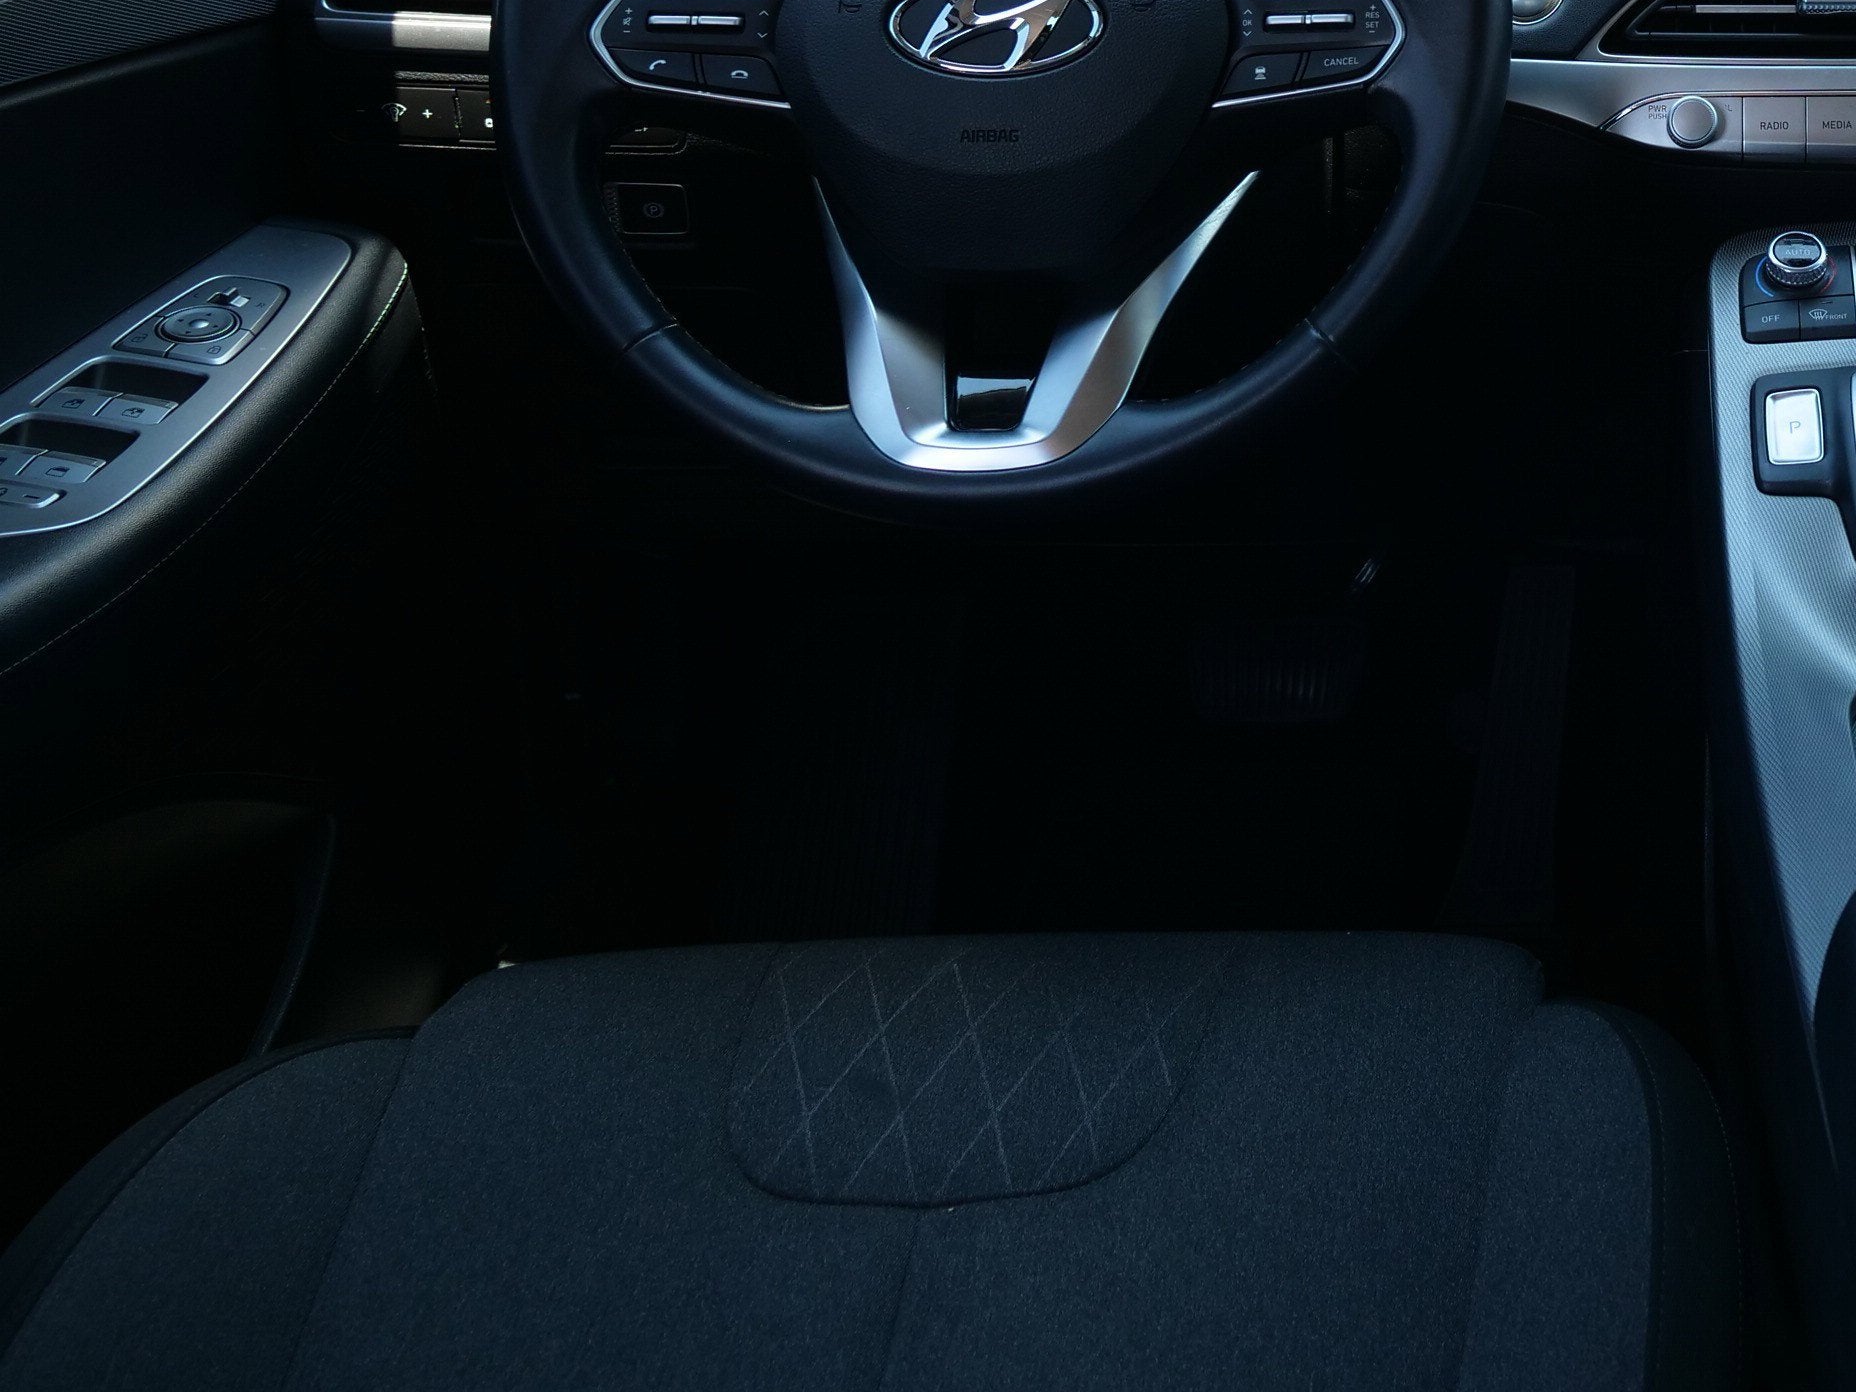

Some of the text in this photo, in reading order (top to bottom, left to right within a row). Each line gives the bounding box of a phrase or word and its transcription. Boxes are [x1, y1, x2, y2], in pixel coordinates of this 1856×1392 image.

[1323, 57, 1359, 67] CANCEL
[1760, 121, 1789, 130] RADIO
[1822, 121, 1852, 130] MEDIA
[960, 129, 1020, 143] AIRBAG
[1761, 314, 1780, 323] OFF
[1825, 312, 1848, 320] FRONT
[1789, 422, 1801, 434] P
